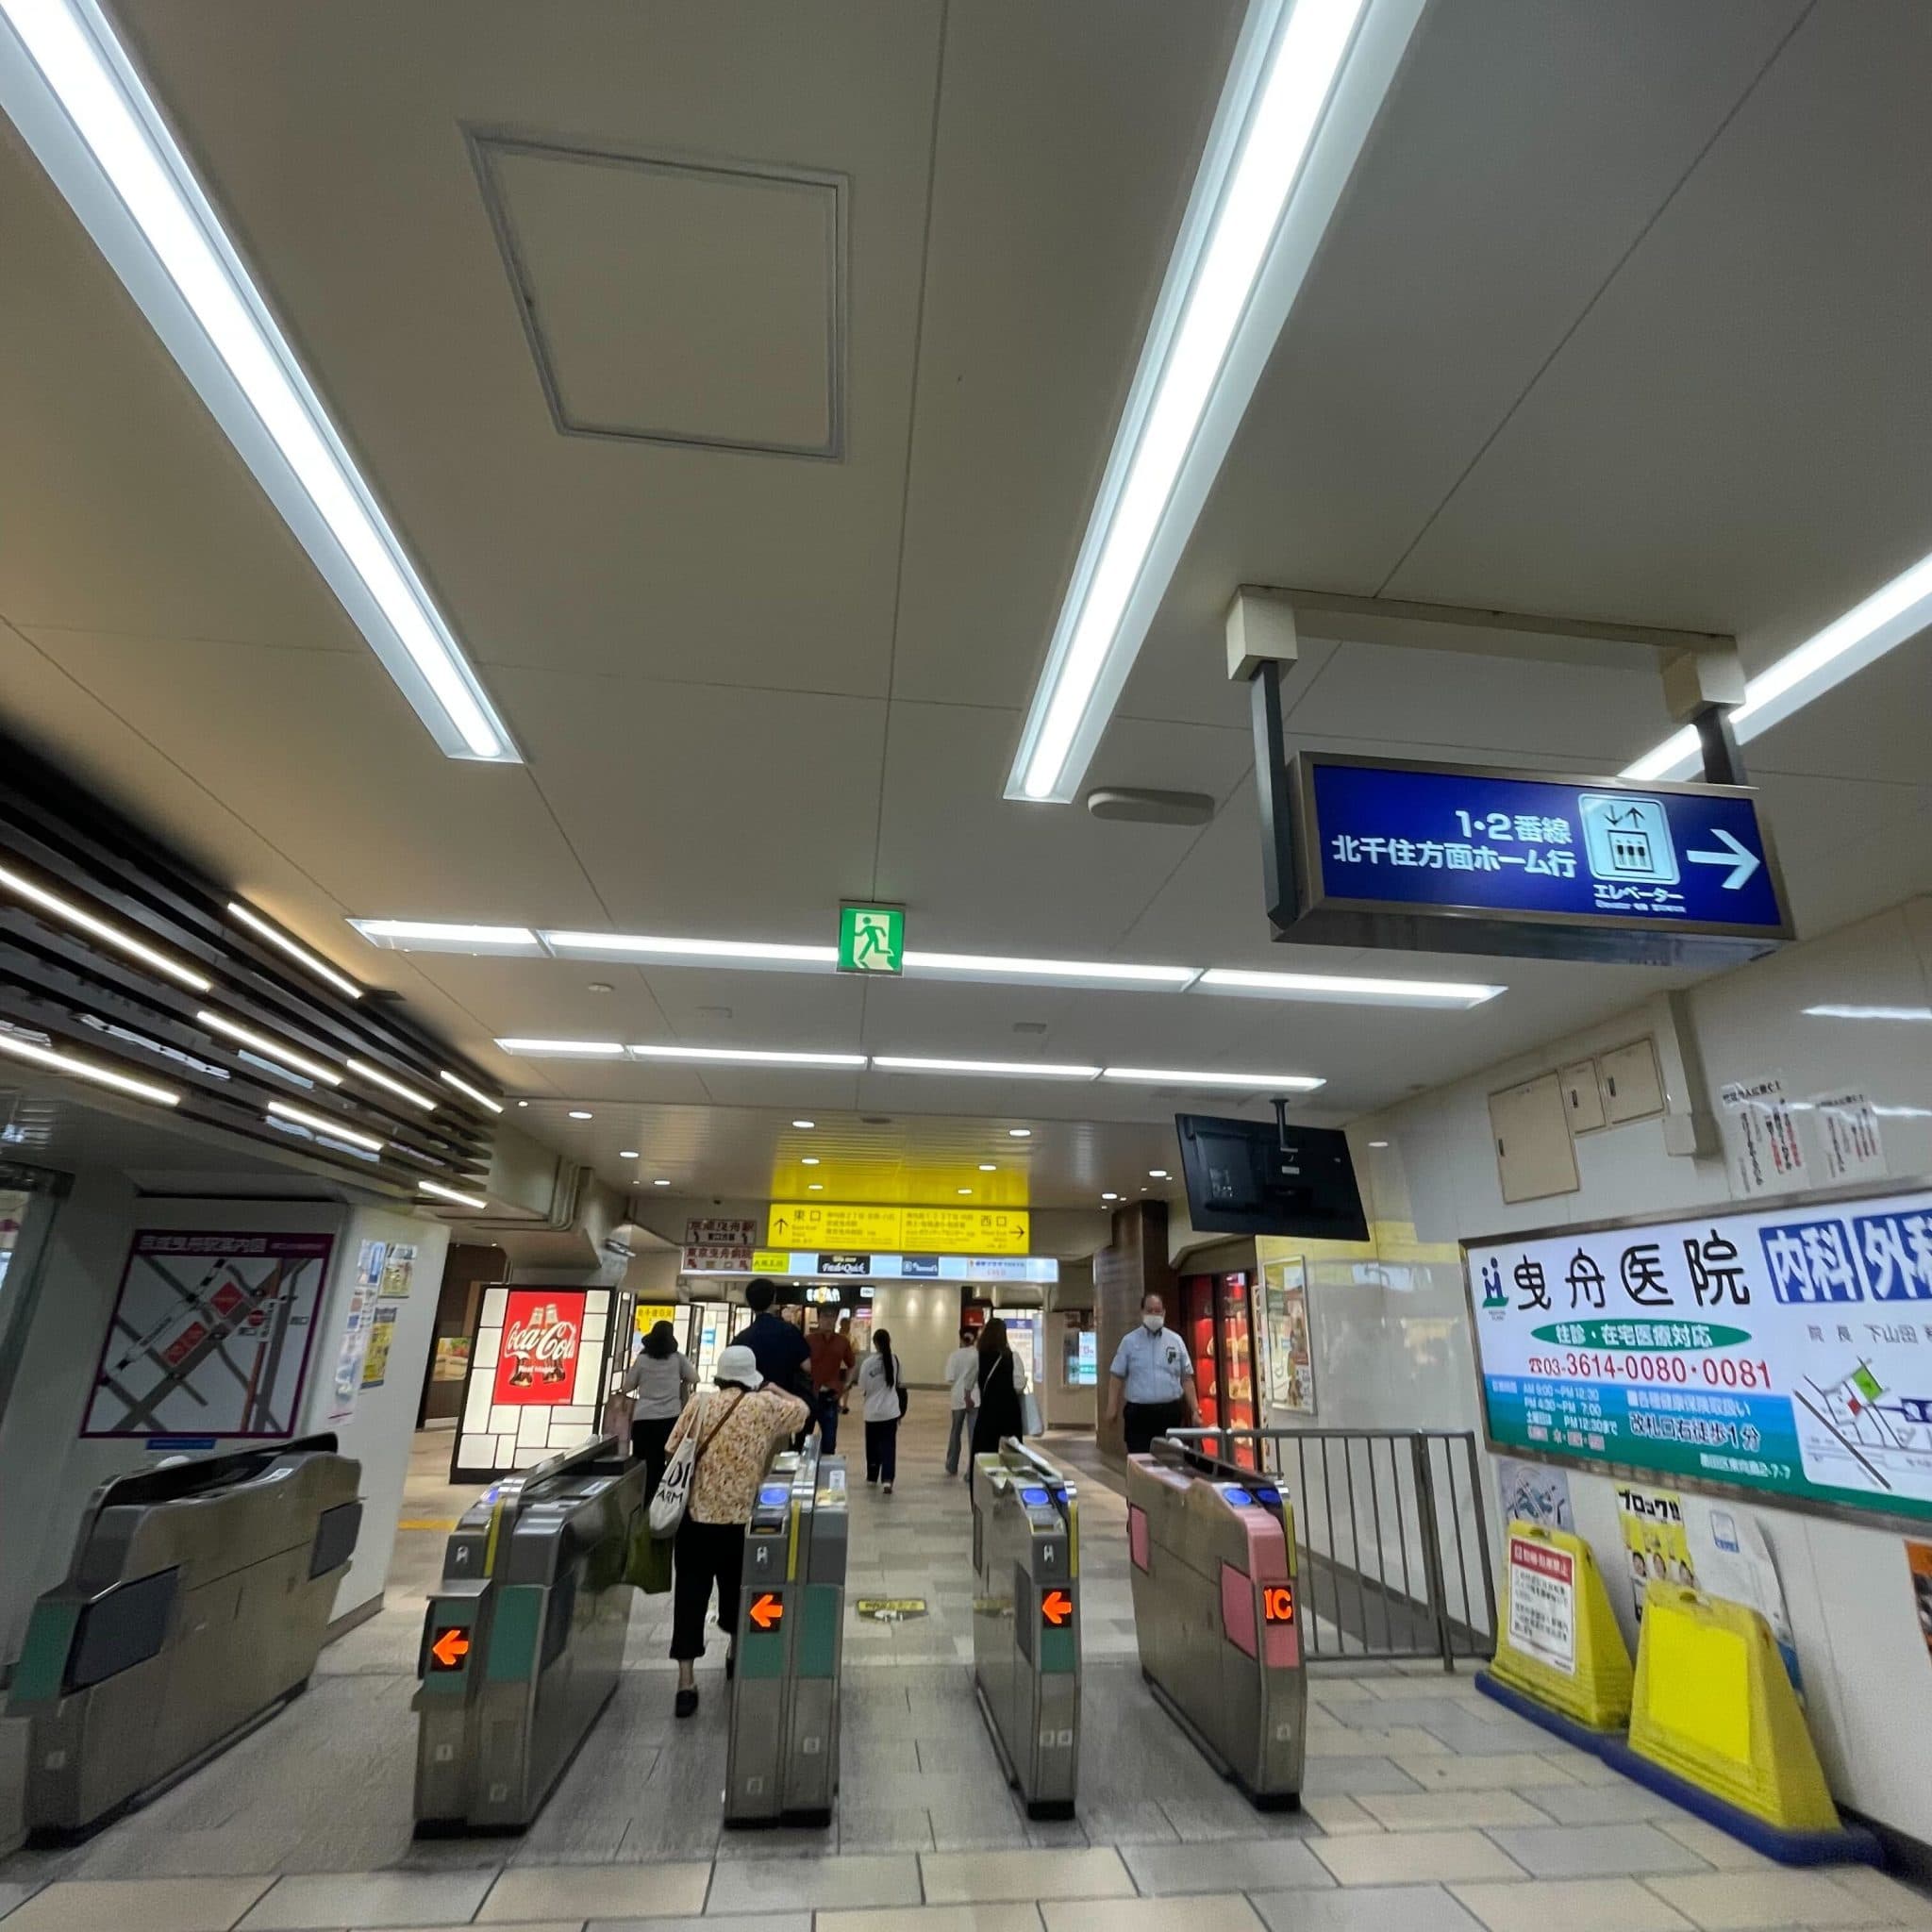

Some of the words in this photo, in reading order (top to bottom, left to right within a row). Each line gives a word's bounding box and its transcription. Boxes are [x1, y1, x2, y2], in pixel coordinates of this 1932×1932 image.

[1332, 835, 1576, 879] 北千住方面ホーム行
[1592, 884, 1685, 903] エレベーター
[1513, 1228, 1751, 1310] 曳舟医院
[1766, 1224, 1857, 1302] 内科
[504, 1321, 576, 1360] Coca-Cola
[1264, 1589, 1291, 1620] IC
